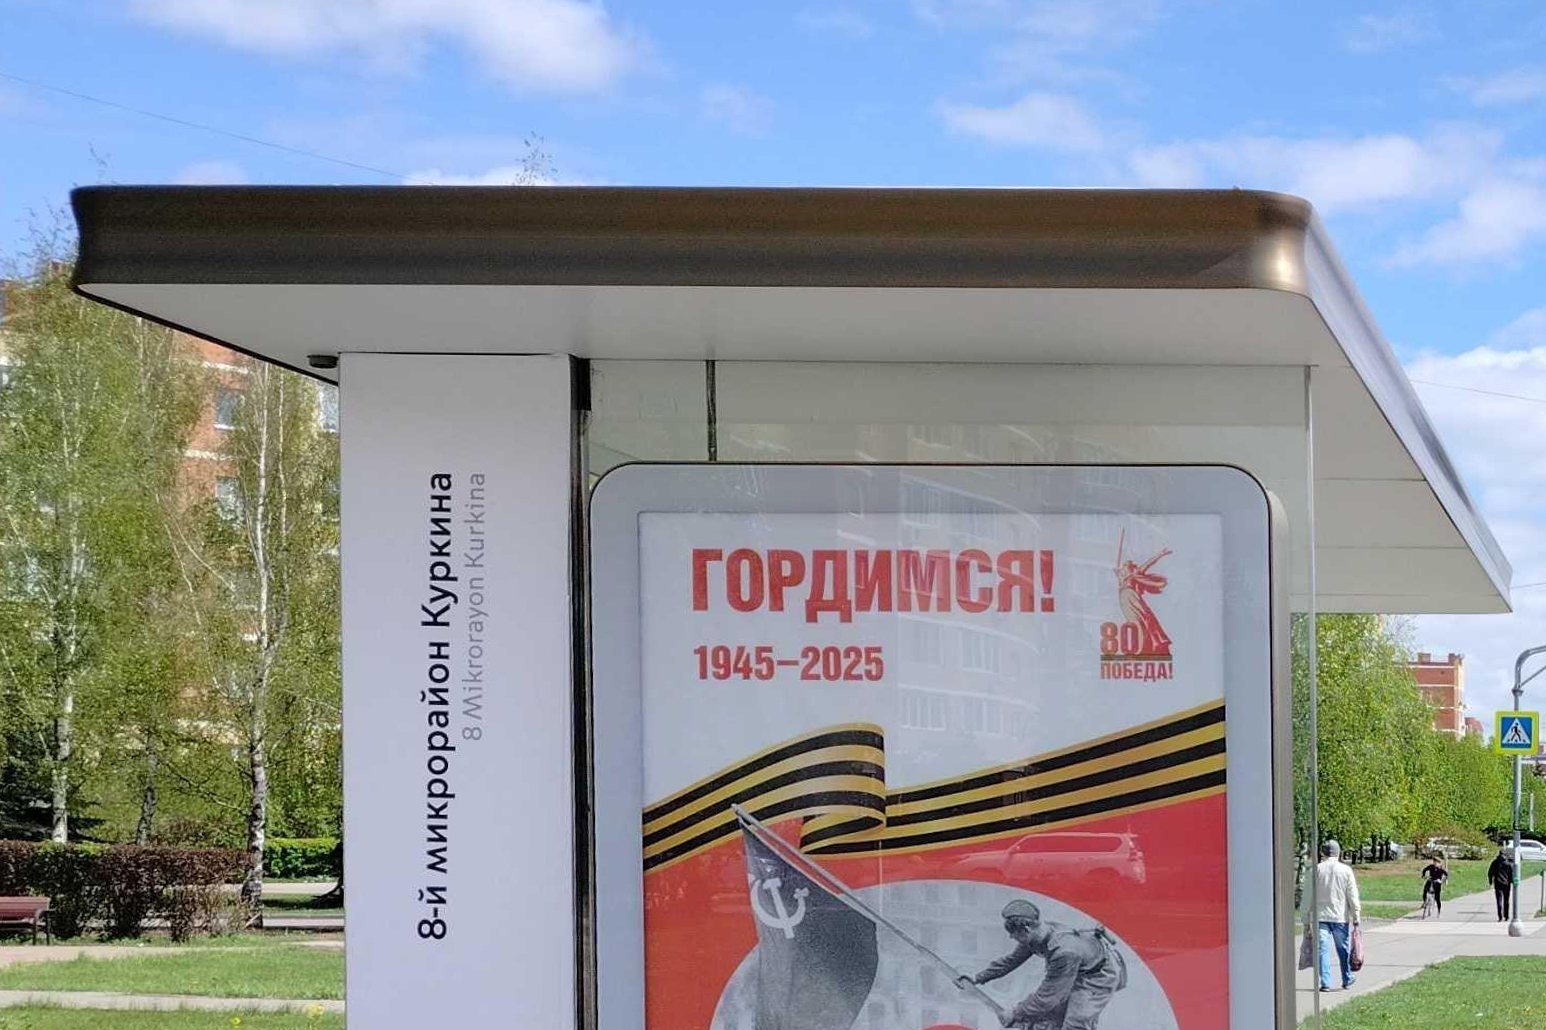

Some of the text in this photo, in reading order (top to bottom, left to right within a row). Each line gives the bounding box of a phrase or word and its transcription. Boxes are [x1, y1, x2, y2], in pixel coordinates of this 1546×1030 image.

[461, 472, 489, 742] 8 Mikrorayon Kurkina
[692, 548, 1055, 623] ГОРДИМСЯ!
[1100, 621, 1140, 655] 80
[1100, 661, 1174, 682] ПОБЕДА!
[417, 473, 459, 940] 8-й микрорайон Куркина
